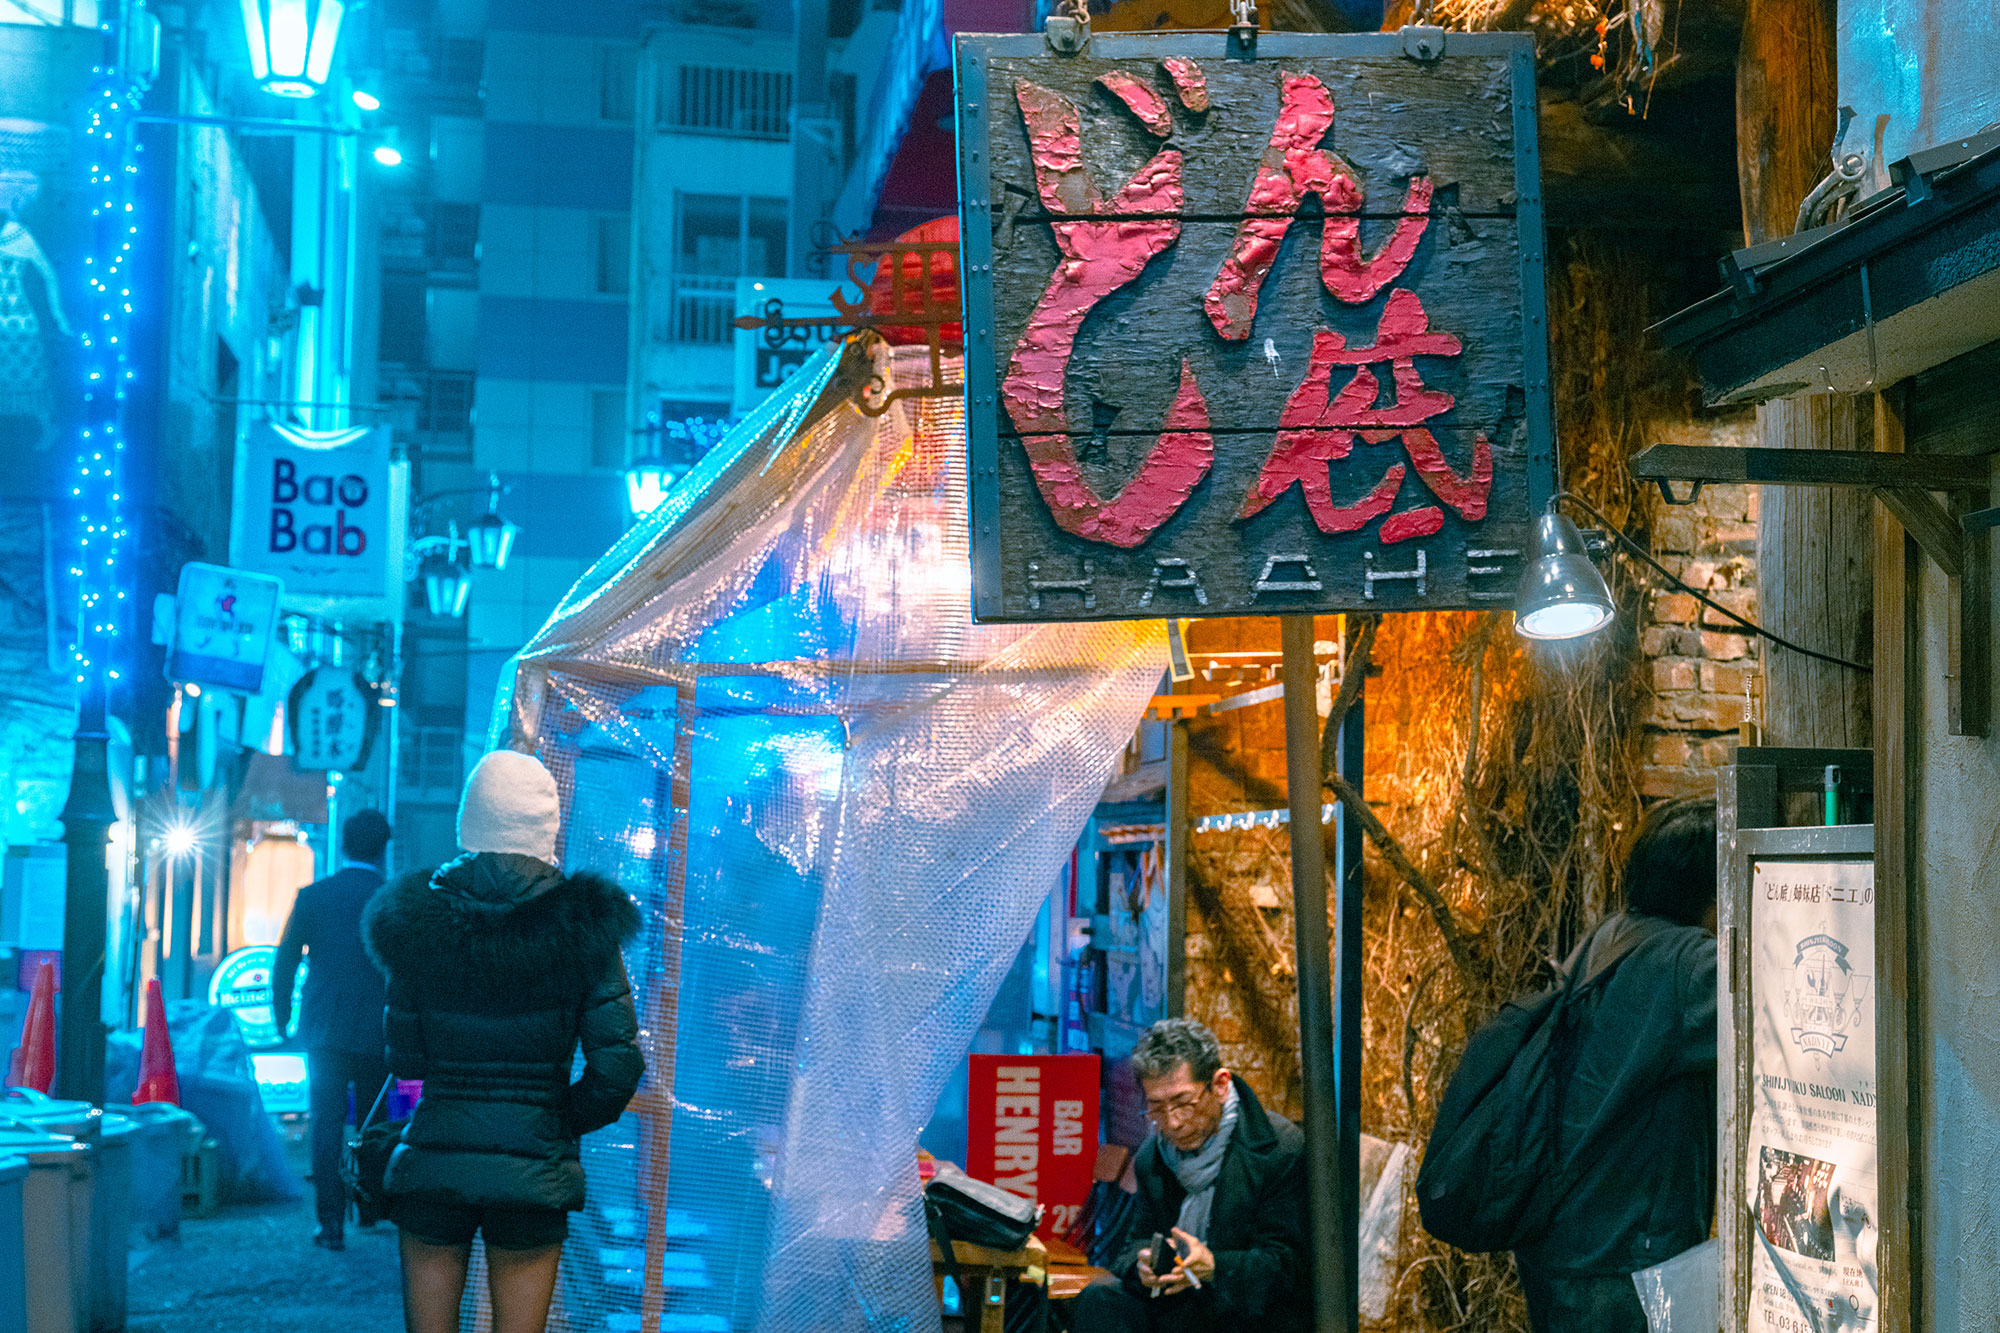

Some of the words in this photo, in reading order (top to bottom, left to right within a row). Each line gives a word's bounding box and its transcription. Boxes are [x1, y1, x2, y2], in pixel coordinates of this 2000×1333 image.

[273, 458, 368, 508] Bao
[270, 508, 366, 556] Bab
[1809, 1083, 1846, 1103] SALOON
[995, 1066, 1040, 1206] HENRY
[1053, 1100, 1083, 1156] BAR
